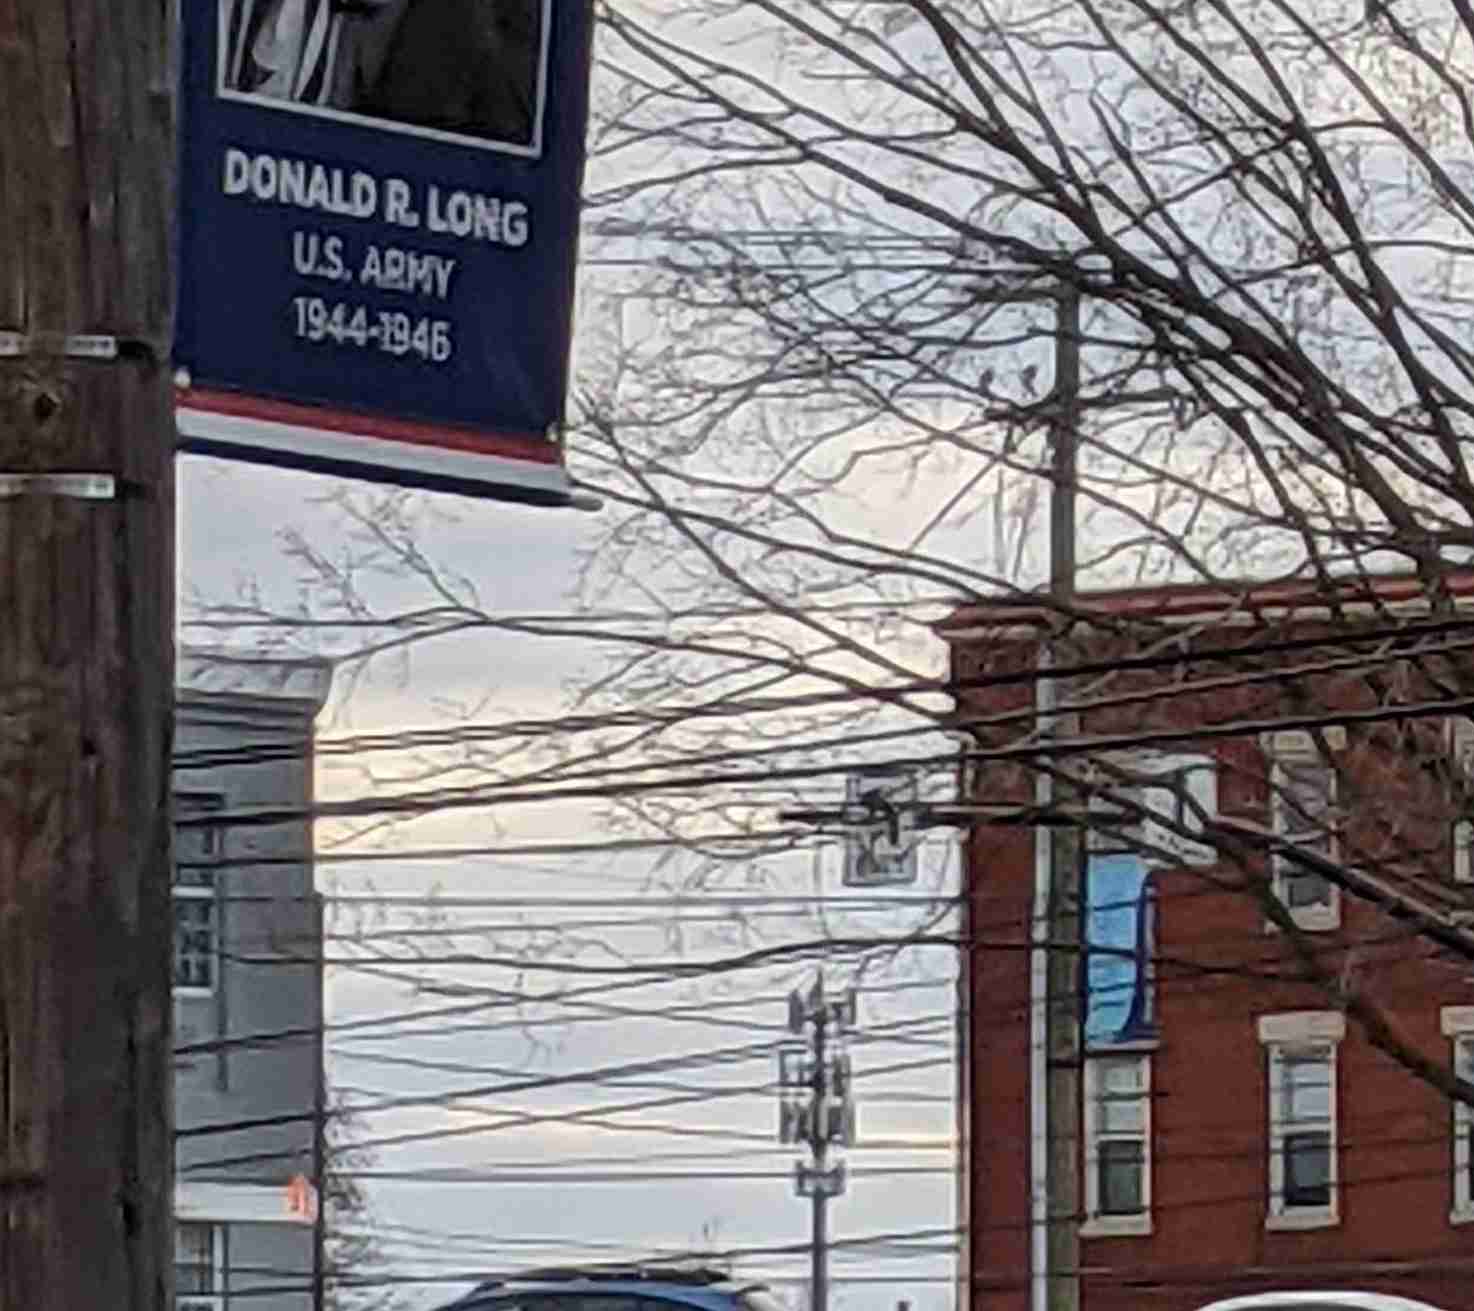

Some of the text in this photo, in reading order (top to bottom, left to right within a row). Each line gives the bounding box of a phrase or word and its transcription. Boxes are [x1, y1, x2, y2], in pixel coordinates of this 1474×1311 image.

[223, 147, 528, 246] DONALD R. LONG
[293, 231, 456, 299] U.S. ARMY
[293, 297, 452, 363] 1944-1946
